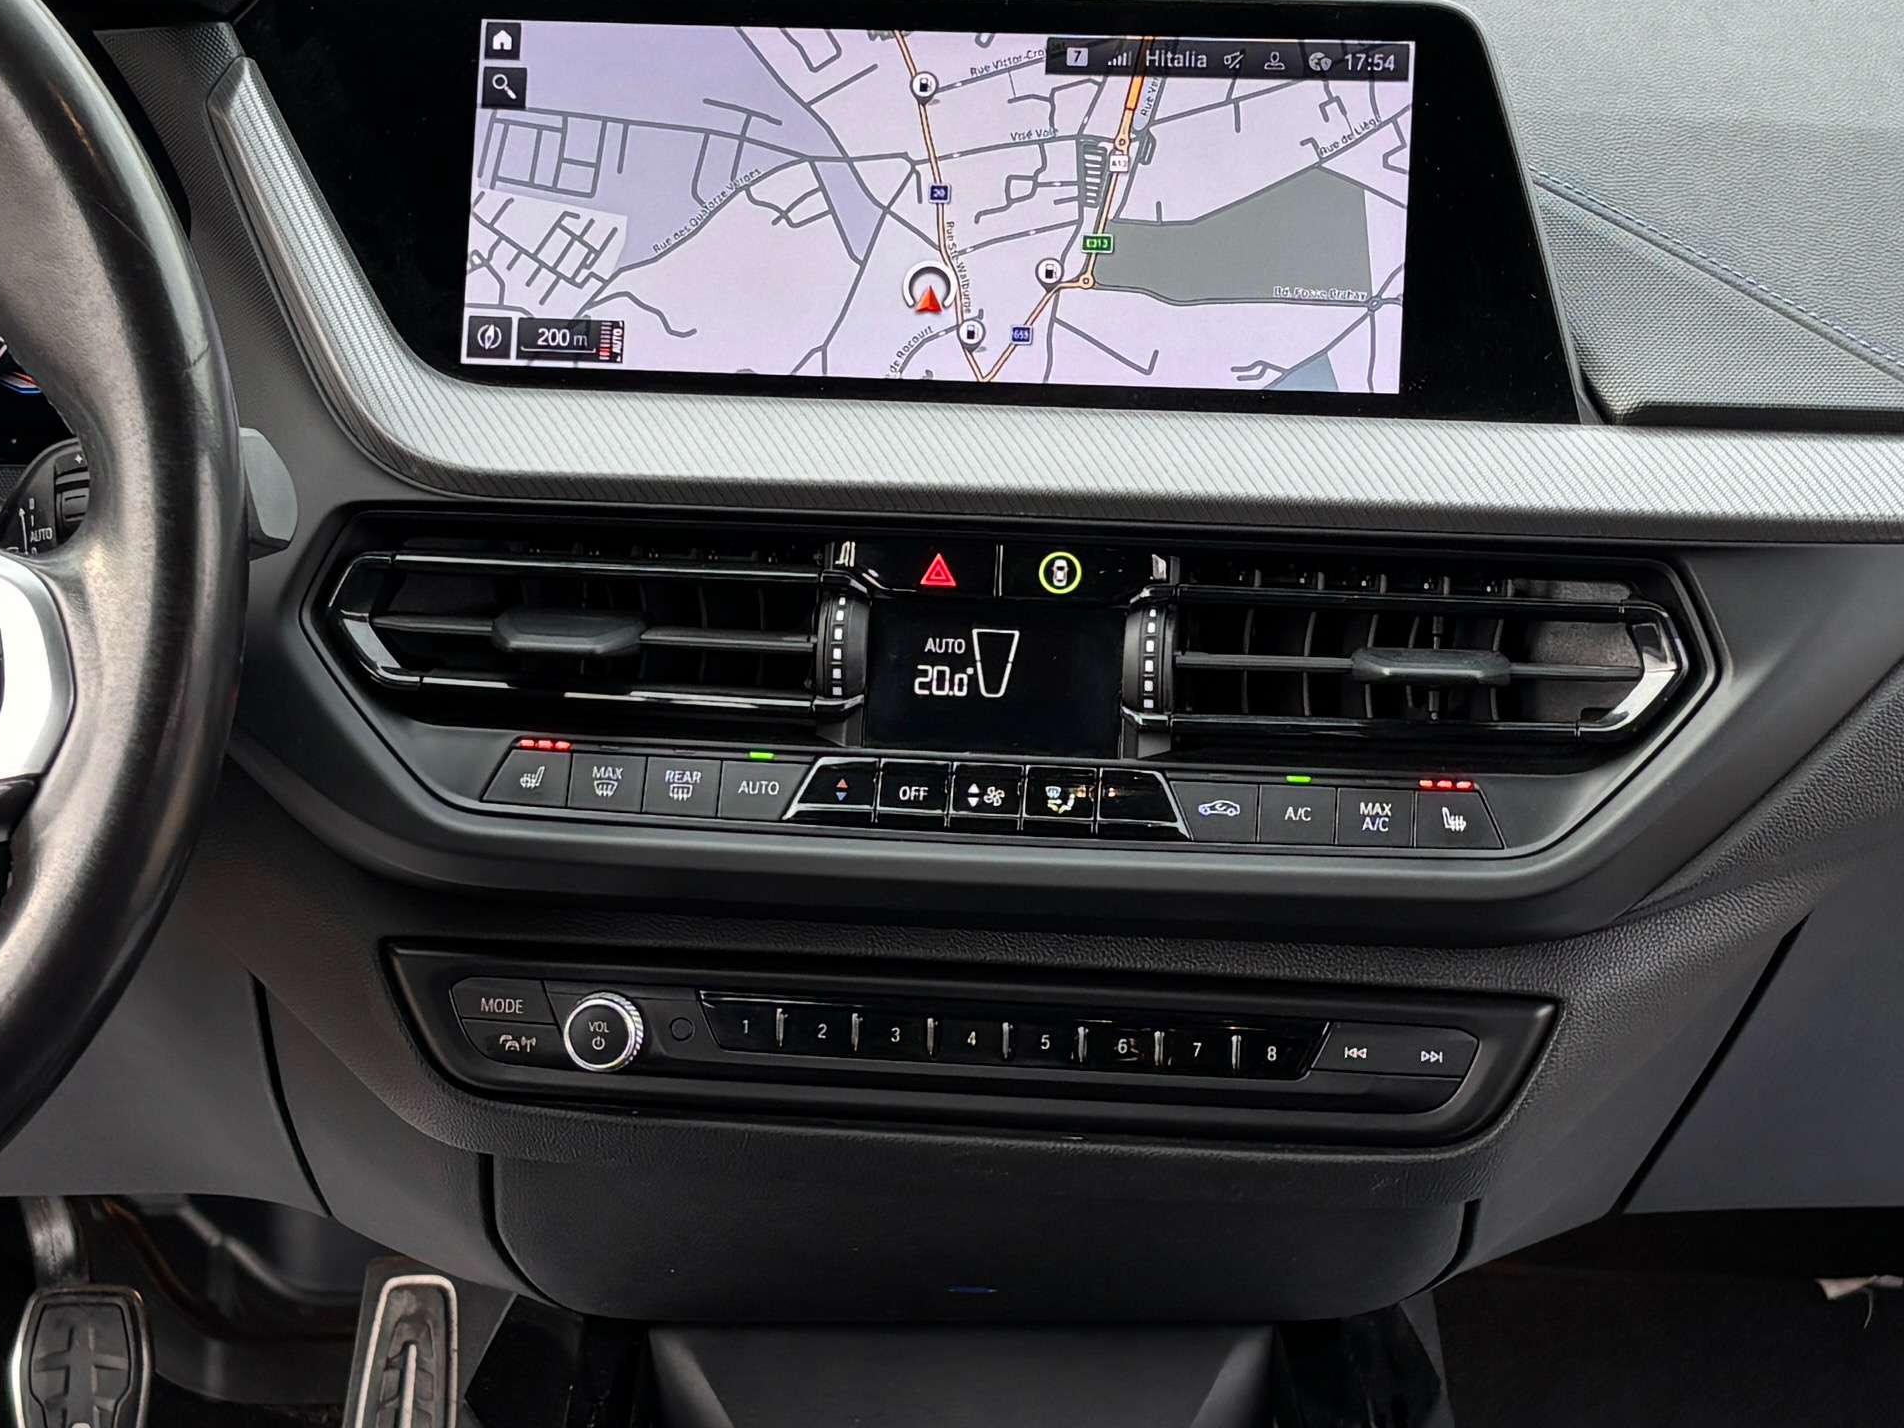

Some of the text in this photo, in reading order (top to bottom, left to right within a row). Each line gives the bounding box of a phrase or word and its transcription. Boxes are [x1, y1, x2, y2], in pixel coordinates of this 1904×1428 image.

[1145, 49, 1207, 69] Hitalia
[1344, 53, 1395, 71] 17:54
[969, 62, 991, 76] Rue
[1319, 140, 1340, 156] Rue
[536, 327, 588, 347] 200 m
[612, 328, 623, 353] AUTO
[30, 527, 53, 543] AUTO
[925, 638, 966, 654] AUTO
[592, 766, 623, 781] MAX
[665, 769, 701, 785] REAR
[738, 779, 780, 797] AUTO
[899, 785, 929, 801] OFF
[1283, 805, 1312, 822] A/C
[1359, 801, 1392, 818] MAX
[1362, 817, 1390, 833] A/C
[480, 997, 524, 1014] MODE
[588, 1020, 610, 1034] VOL
[742, 1019, 1277, 1061] 1 2 3 4 5 6 7 8
